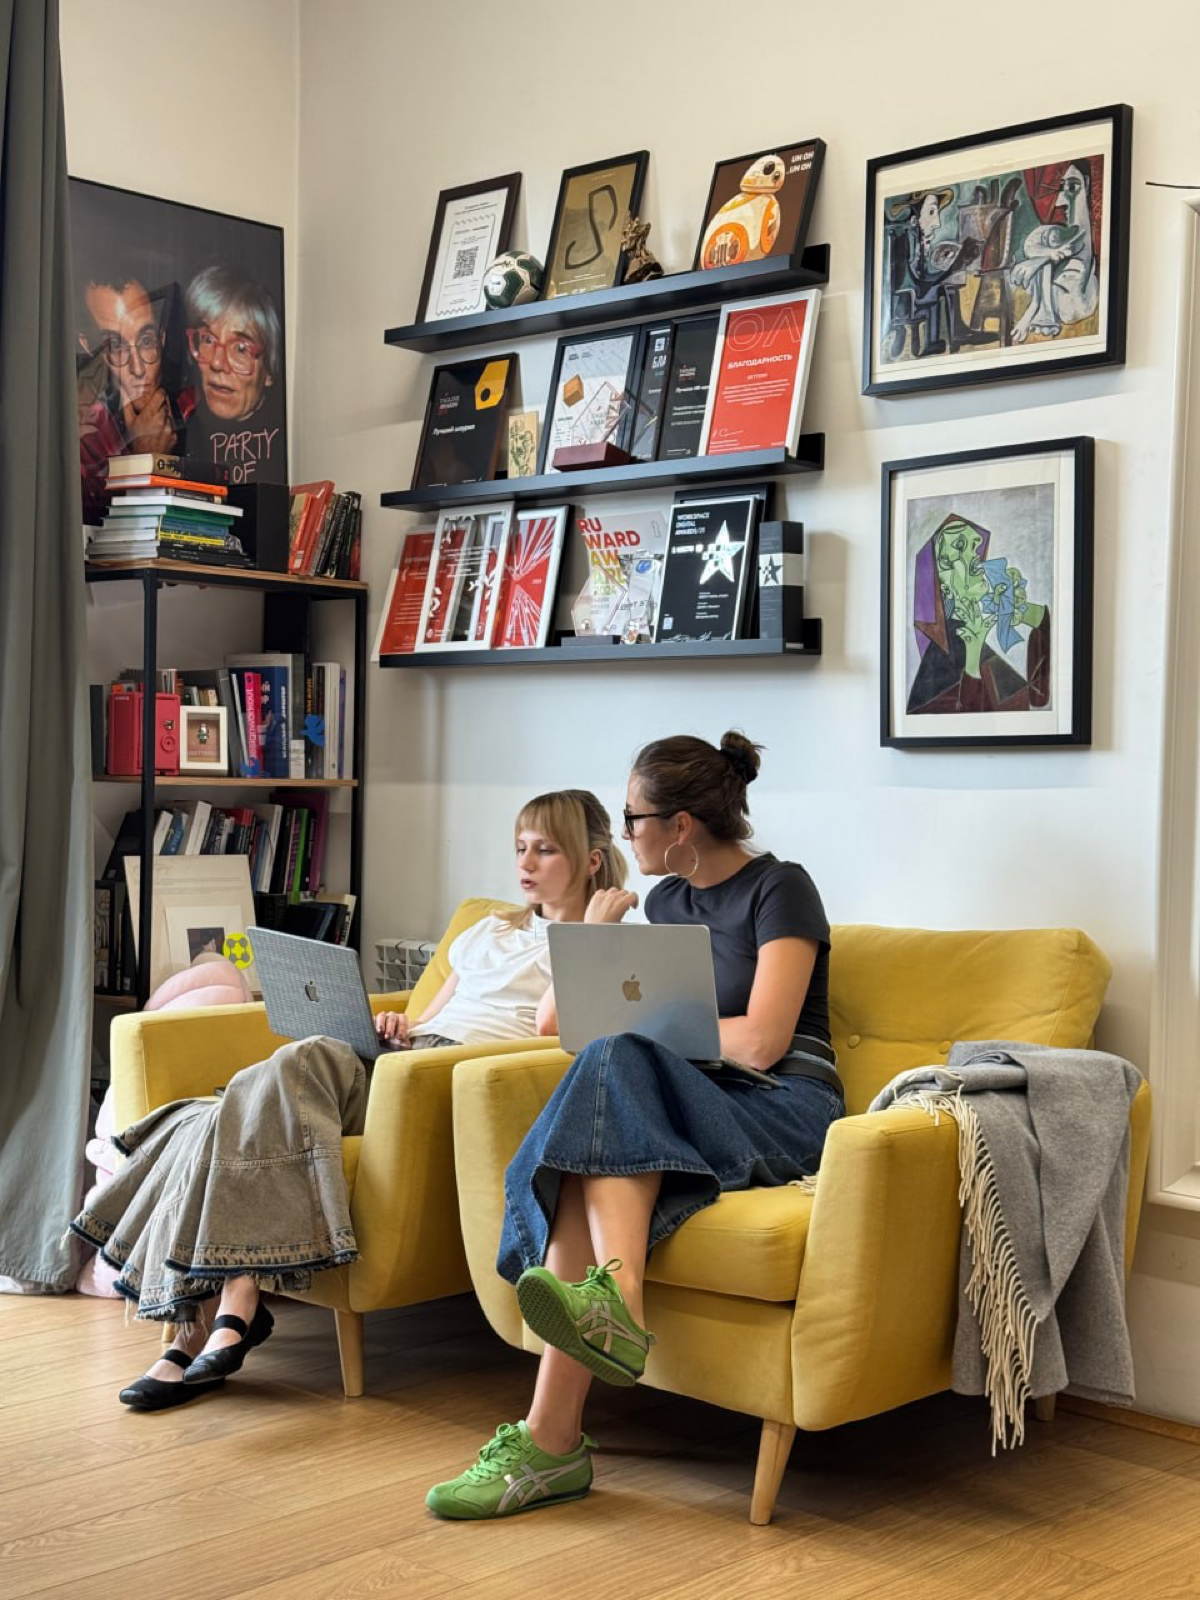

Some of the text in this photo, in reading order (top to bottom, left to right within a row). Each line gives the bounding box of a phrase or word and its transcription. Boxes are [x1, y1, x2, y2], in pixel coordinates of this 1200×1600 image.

[727, 353, 793, 370] БЛАГОДАРНОСТЬ
[210, 428, 279, 464] PARTY
[233, 460, 257, 484] OF
[578, 517, 602, 534] RU
[584, 531, 640, 549] WARD
